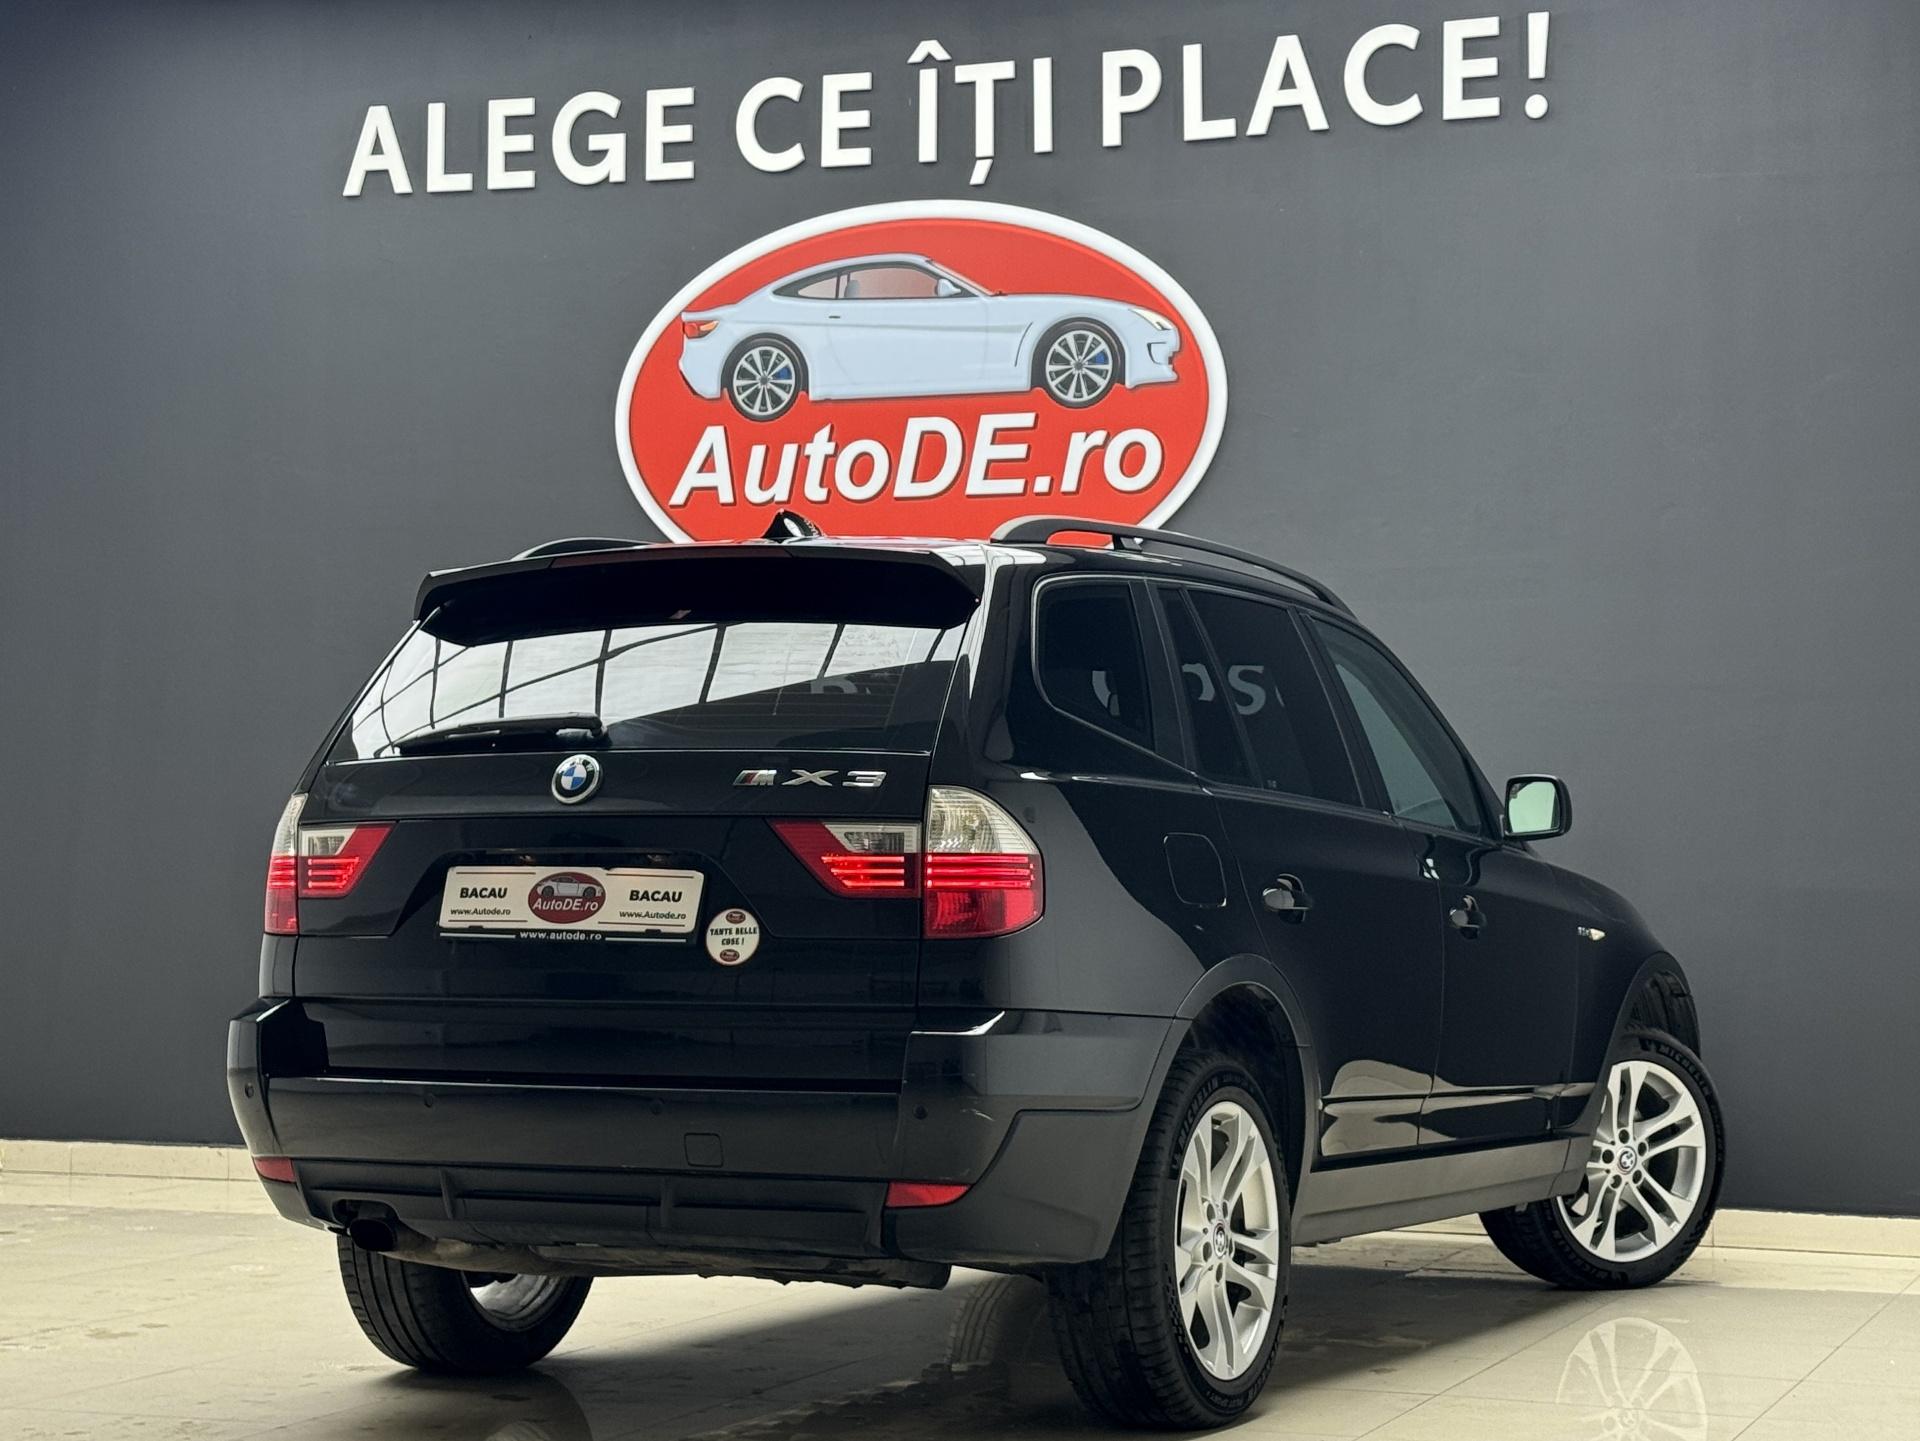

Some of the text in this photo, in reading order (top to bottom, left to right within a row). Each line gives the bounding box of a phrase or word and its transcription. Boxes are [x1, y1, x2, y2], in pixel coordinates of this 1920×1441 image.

[342, 87, 695, 197] ALEGE
[735, 72, 873, 172] CE
[1102, 11, 1550, 148] PLACE!
[669, 413, 1163, 506] AutoDE.ro
[459, 887, 508, 899] BACAU
[629, 890, 683, 903] BACAU
[532, 897, 600, 912] AutoDE.ro
[450, 907, 512, 916] www.Autode.ro
[618, 910, 687, 921] www.Autode.ro
[519, 930, 602, 941] www.autode.ro
